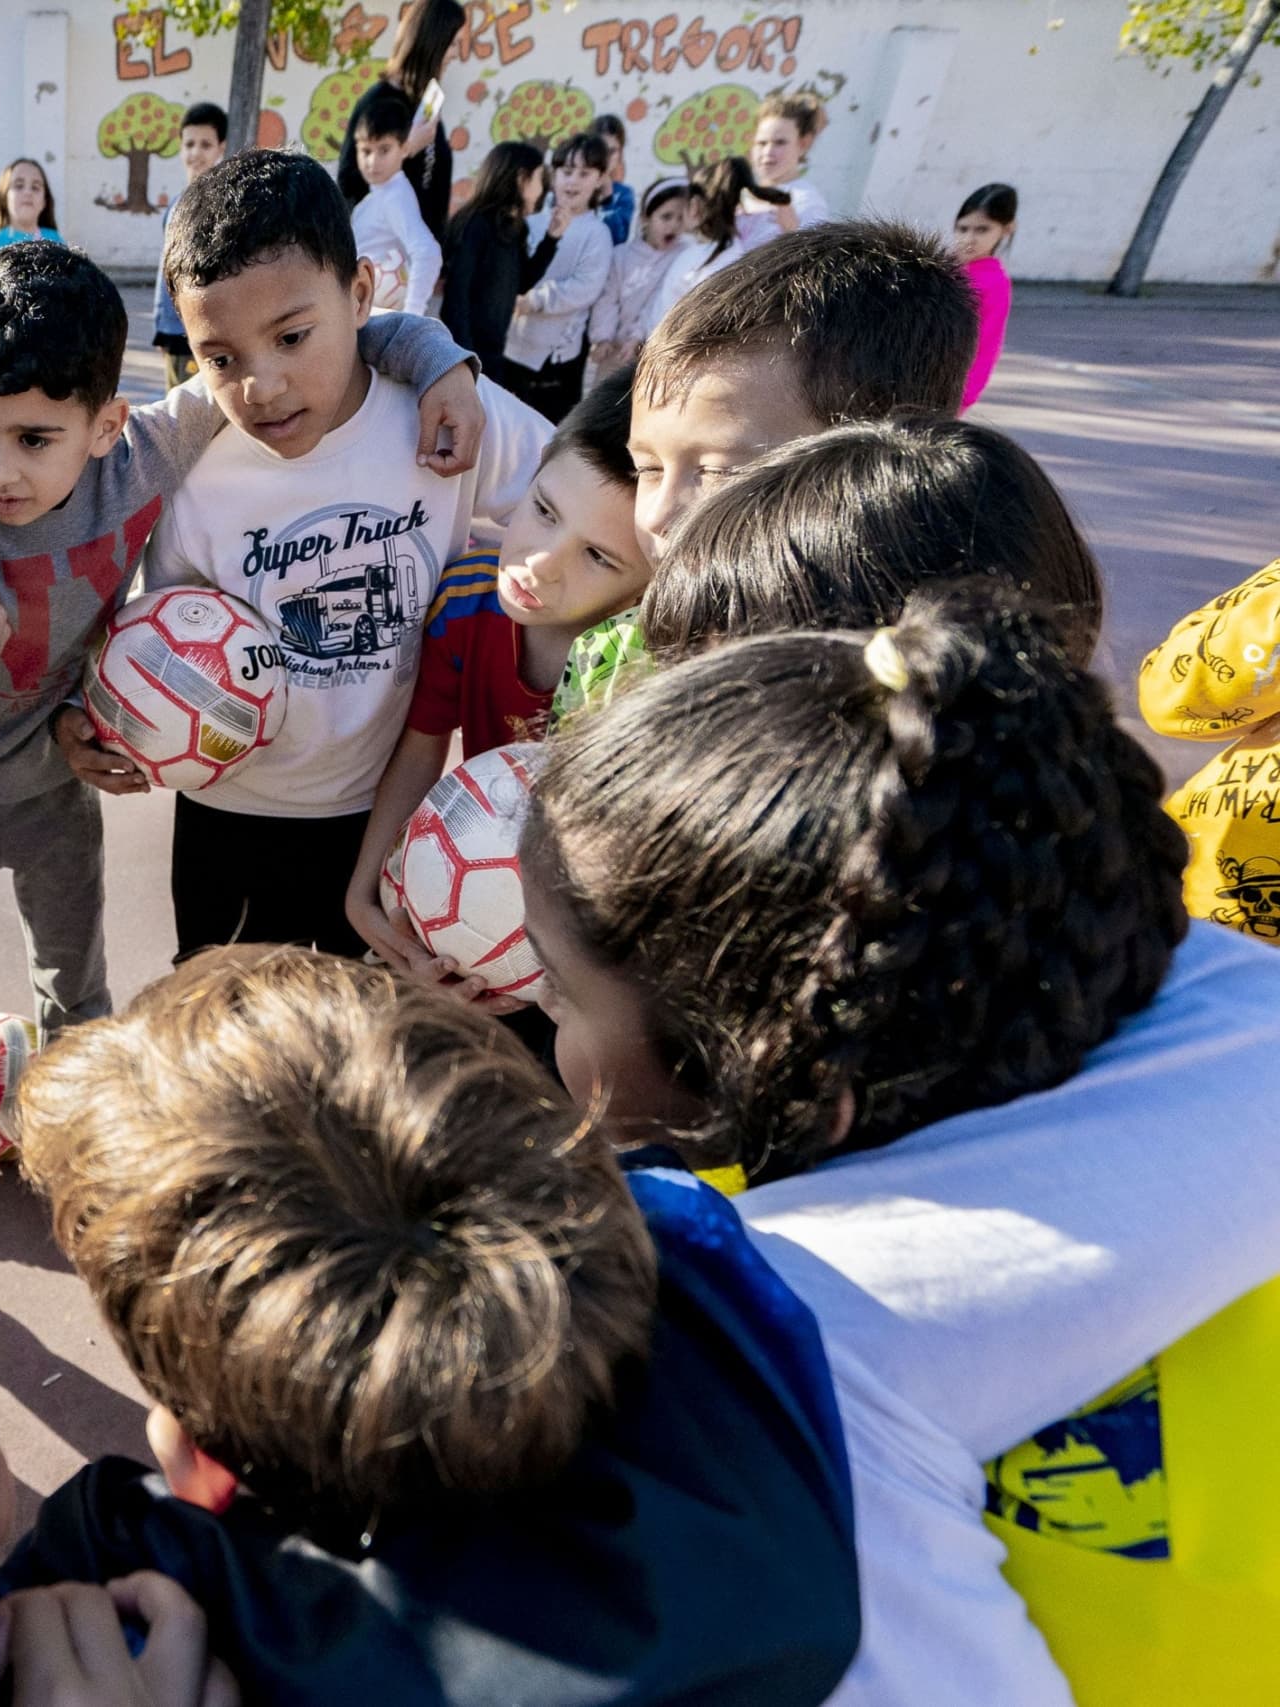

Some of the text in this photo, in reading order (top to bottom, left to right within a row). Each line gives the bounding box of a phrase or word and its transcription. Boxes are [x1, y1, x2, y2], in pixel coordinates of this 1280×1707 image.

[114, 8, 192, 80] EL
[242, 499, 430, 580] Super Truck
[287, 670, 371, 690] REEWAY
